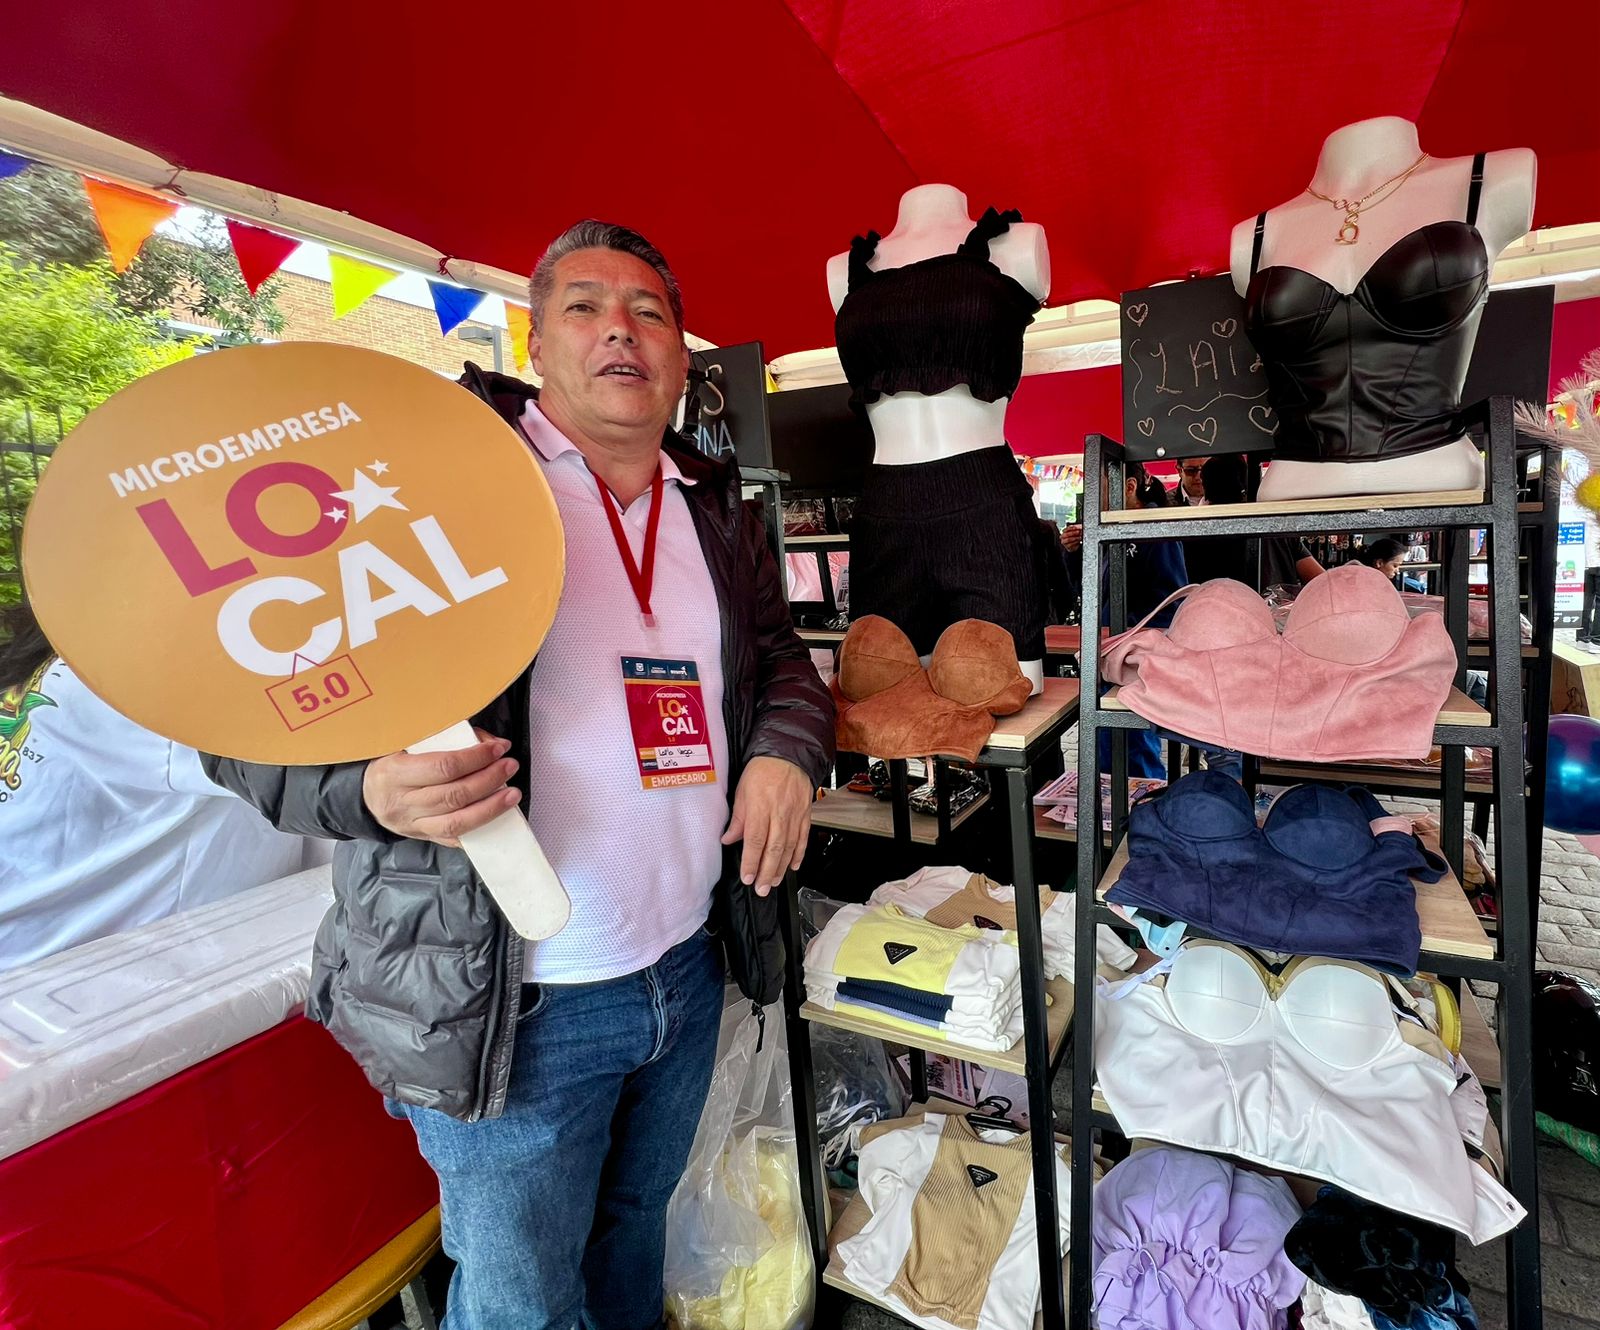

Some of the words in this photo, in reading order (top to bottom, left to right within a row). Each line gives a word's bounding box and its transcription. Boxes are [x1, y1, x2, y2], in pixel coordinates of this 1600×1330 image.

[109, 402, 362, 497] MICROEMPRESA
[135, 461, 350, 598] LO
[217, 514, 509, 677] CAL
[291, 671, 350, 713] 5.0
[658, 699, 681, 718] LO
[662, 717, 699, 736] CAL
[22, 746, 45, 763] 837
[651, 772, 707, 788] EMPRESARIO
